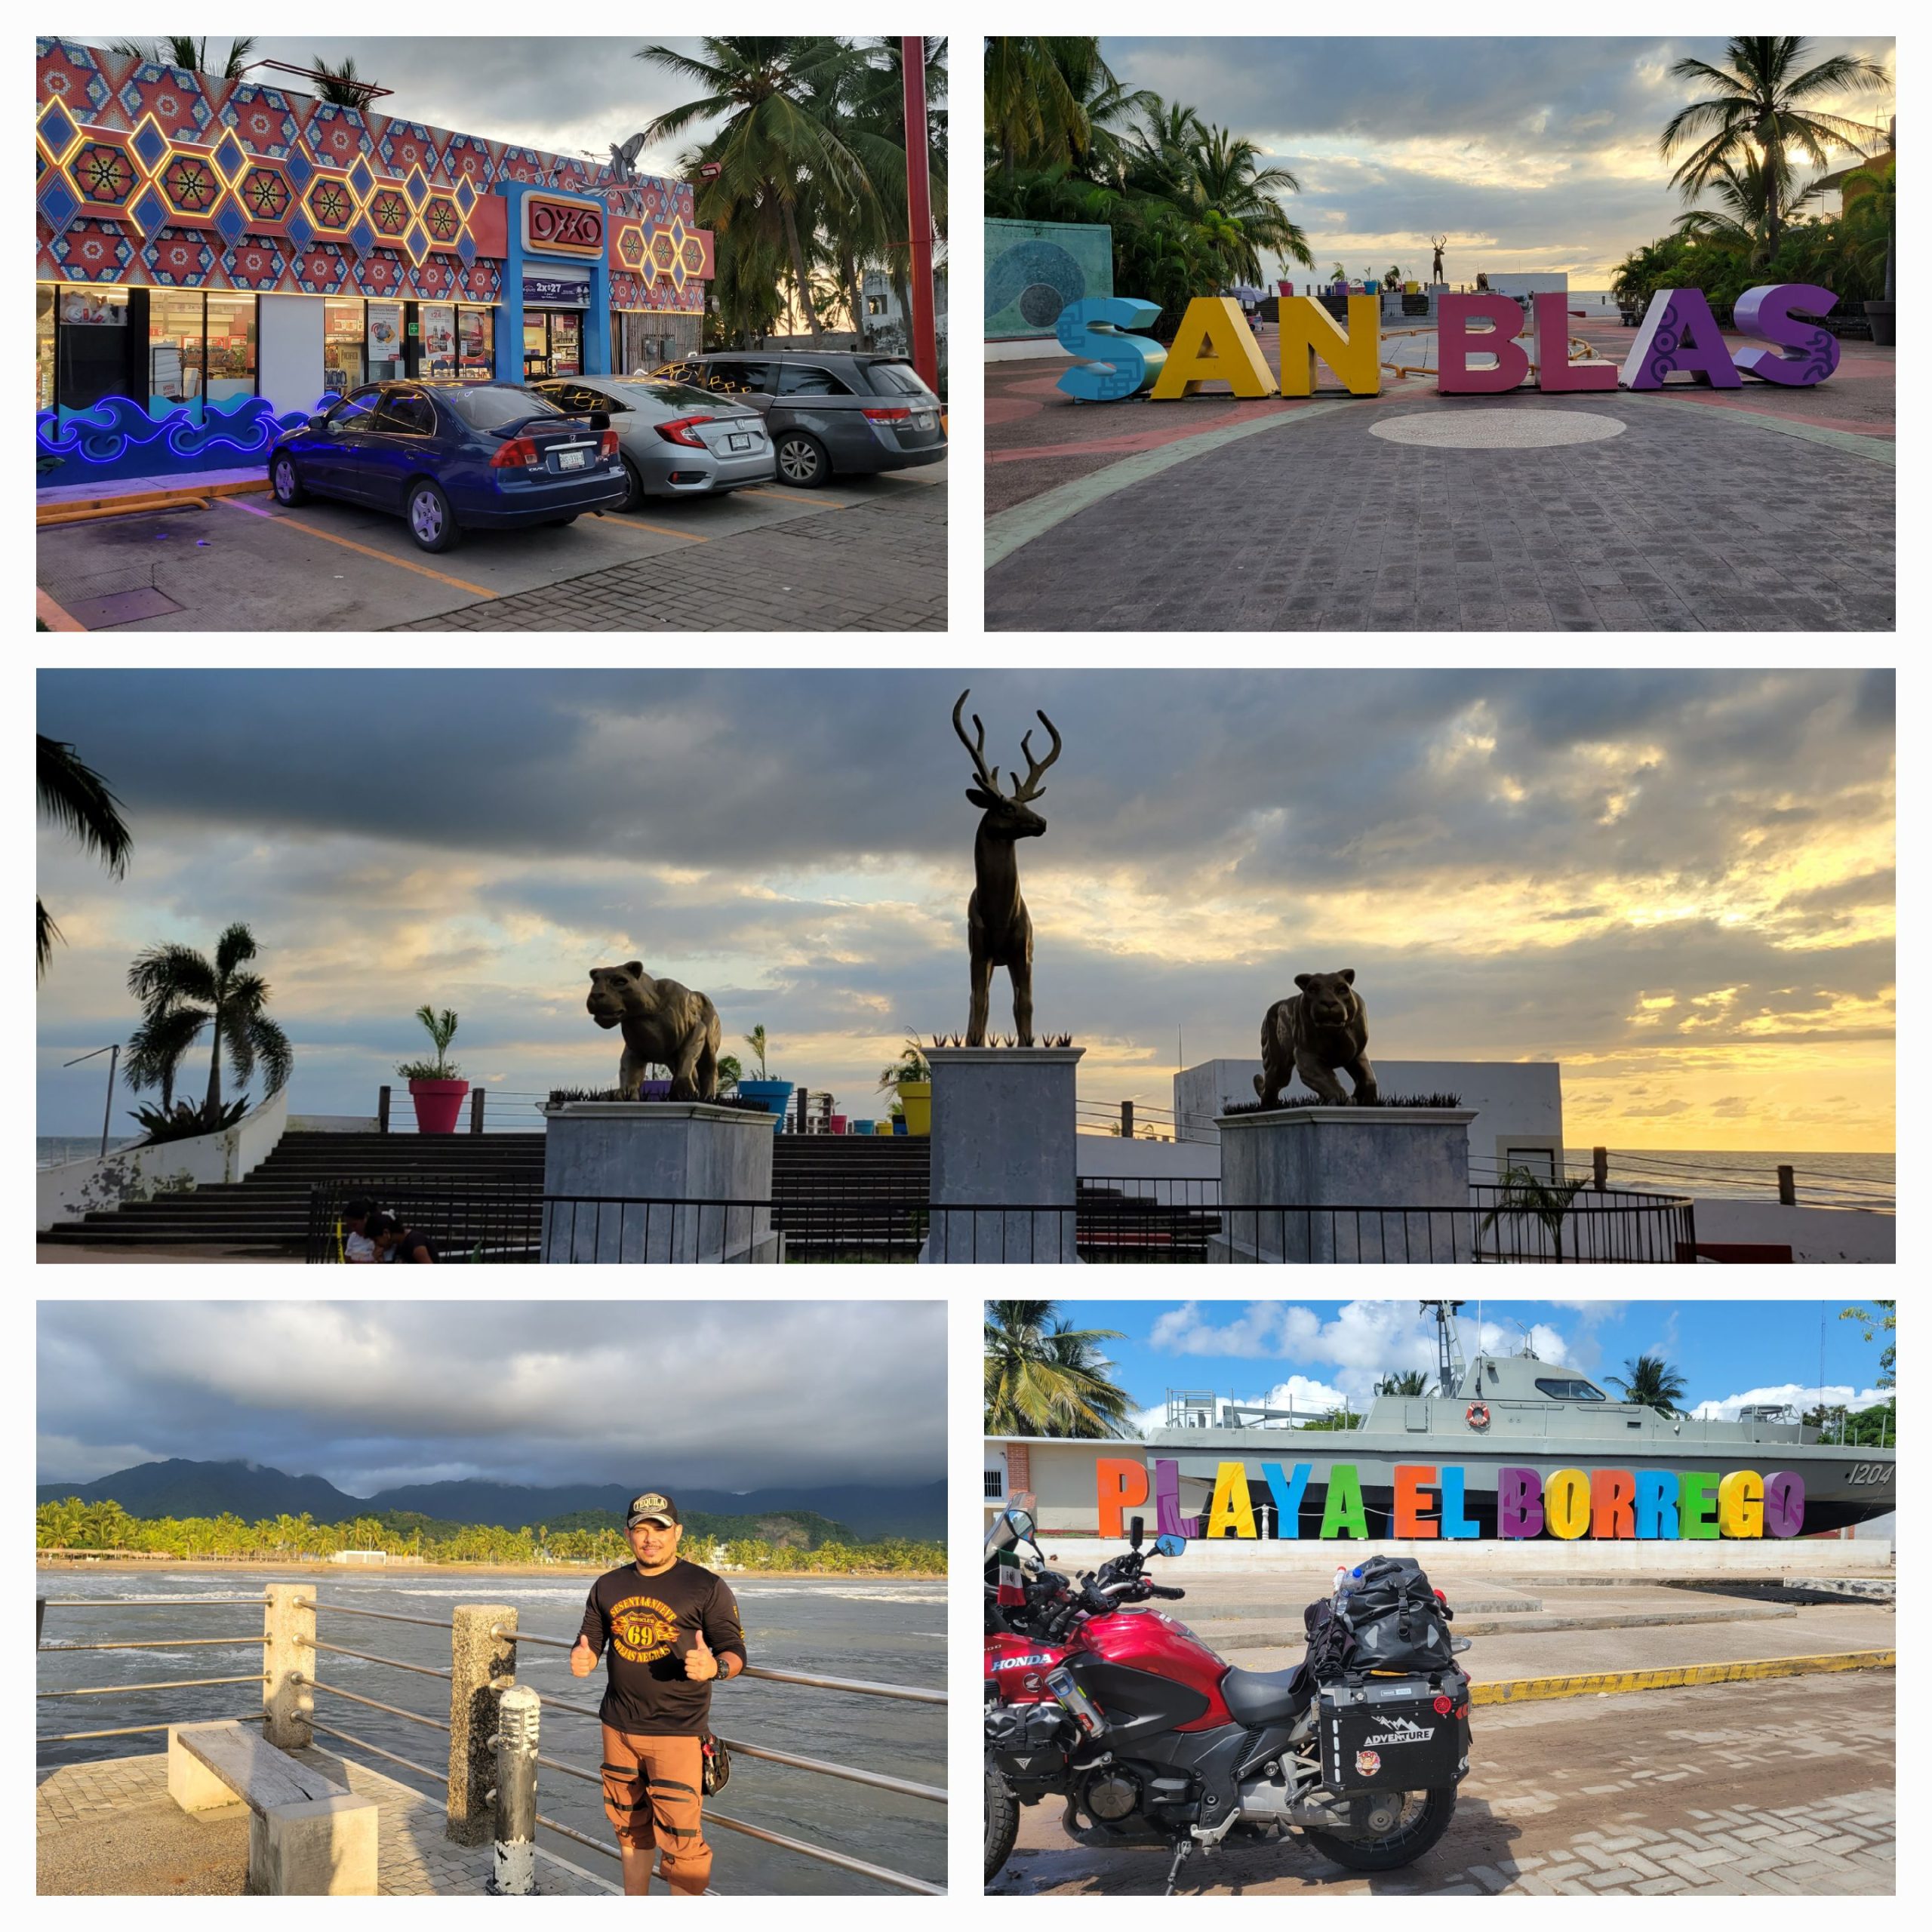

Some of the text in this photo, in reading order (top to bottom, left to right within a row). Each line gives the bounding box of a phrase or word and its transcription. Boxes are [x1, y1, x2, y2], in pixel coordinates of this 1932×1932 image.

[534, 207, 601, 242] OXXO
[1056, 283, 1841, 401] SAN BLAS
[1848, 1463, 1896, 1484] 1204
[635, 1497, 665, 1509] TEQUILA
[1096, 1458, 1805, 1540] PLAYA EL BORREGO
[627, 1626, 653, 1646] 69
[614, 1638, 671, 1663] OVEJAS NEGRAS
[991, 1654, 1053, 1672] HONDA
[1364, 1730, 1431, 1745] ADVENTURE
